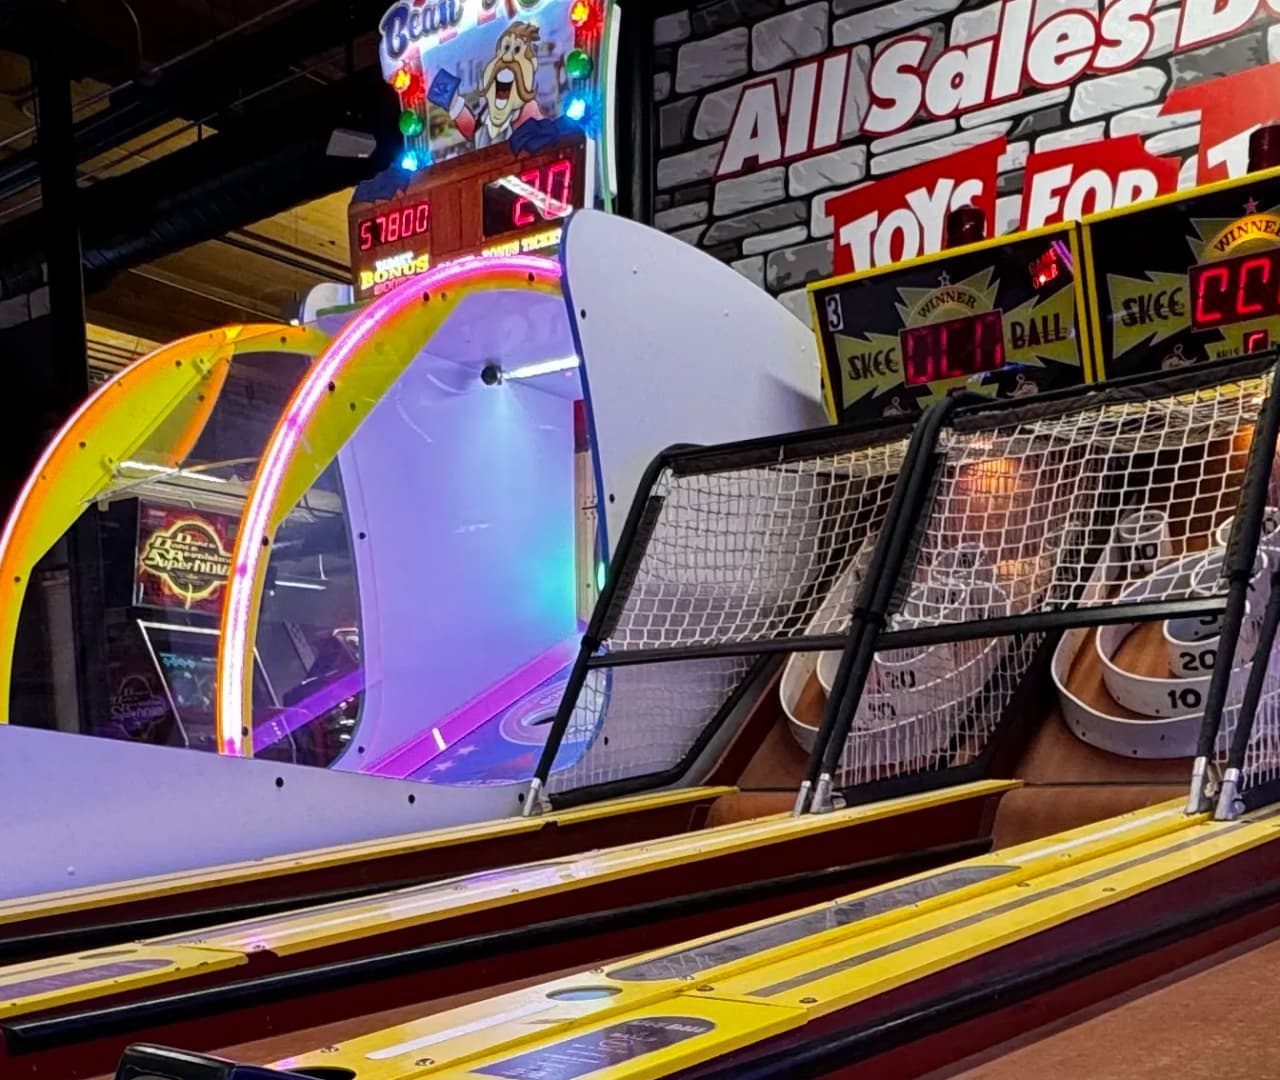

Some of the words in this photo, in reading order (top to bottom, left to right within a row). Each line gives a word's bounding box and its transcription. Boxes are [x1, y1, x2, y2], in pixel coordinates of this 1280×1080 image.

[380, 0, 464, 58] Bean
[715, 50, 851, 178] All
[860, 0, 1156, 134] Sales
[513, 161, 571, 226] 20
[360, 203, 429, 250] 57800
[360, 253, 430, 290] BONUS
[827, 297, 842, 330] 3
[918, 290, 977, 319] WINNER
[1121, 286, 1186, 327] SKEE
[848, 346, 899, 381] SKEE
[1010, 312, 1068, 351] BALL
[1179, 650, 1217, 672] 20
[1167, 687, 1202, 709] 10
